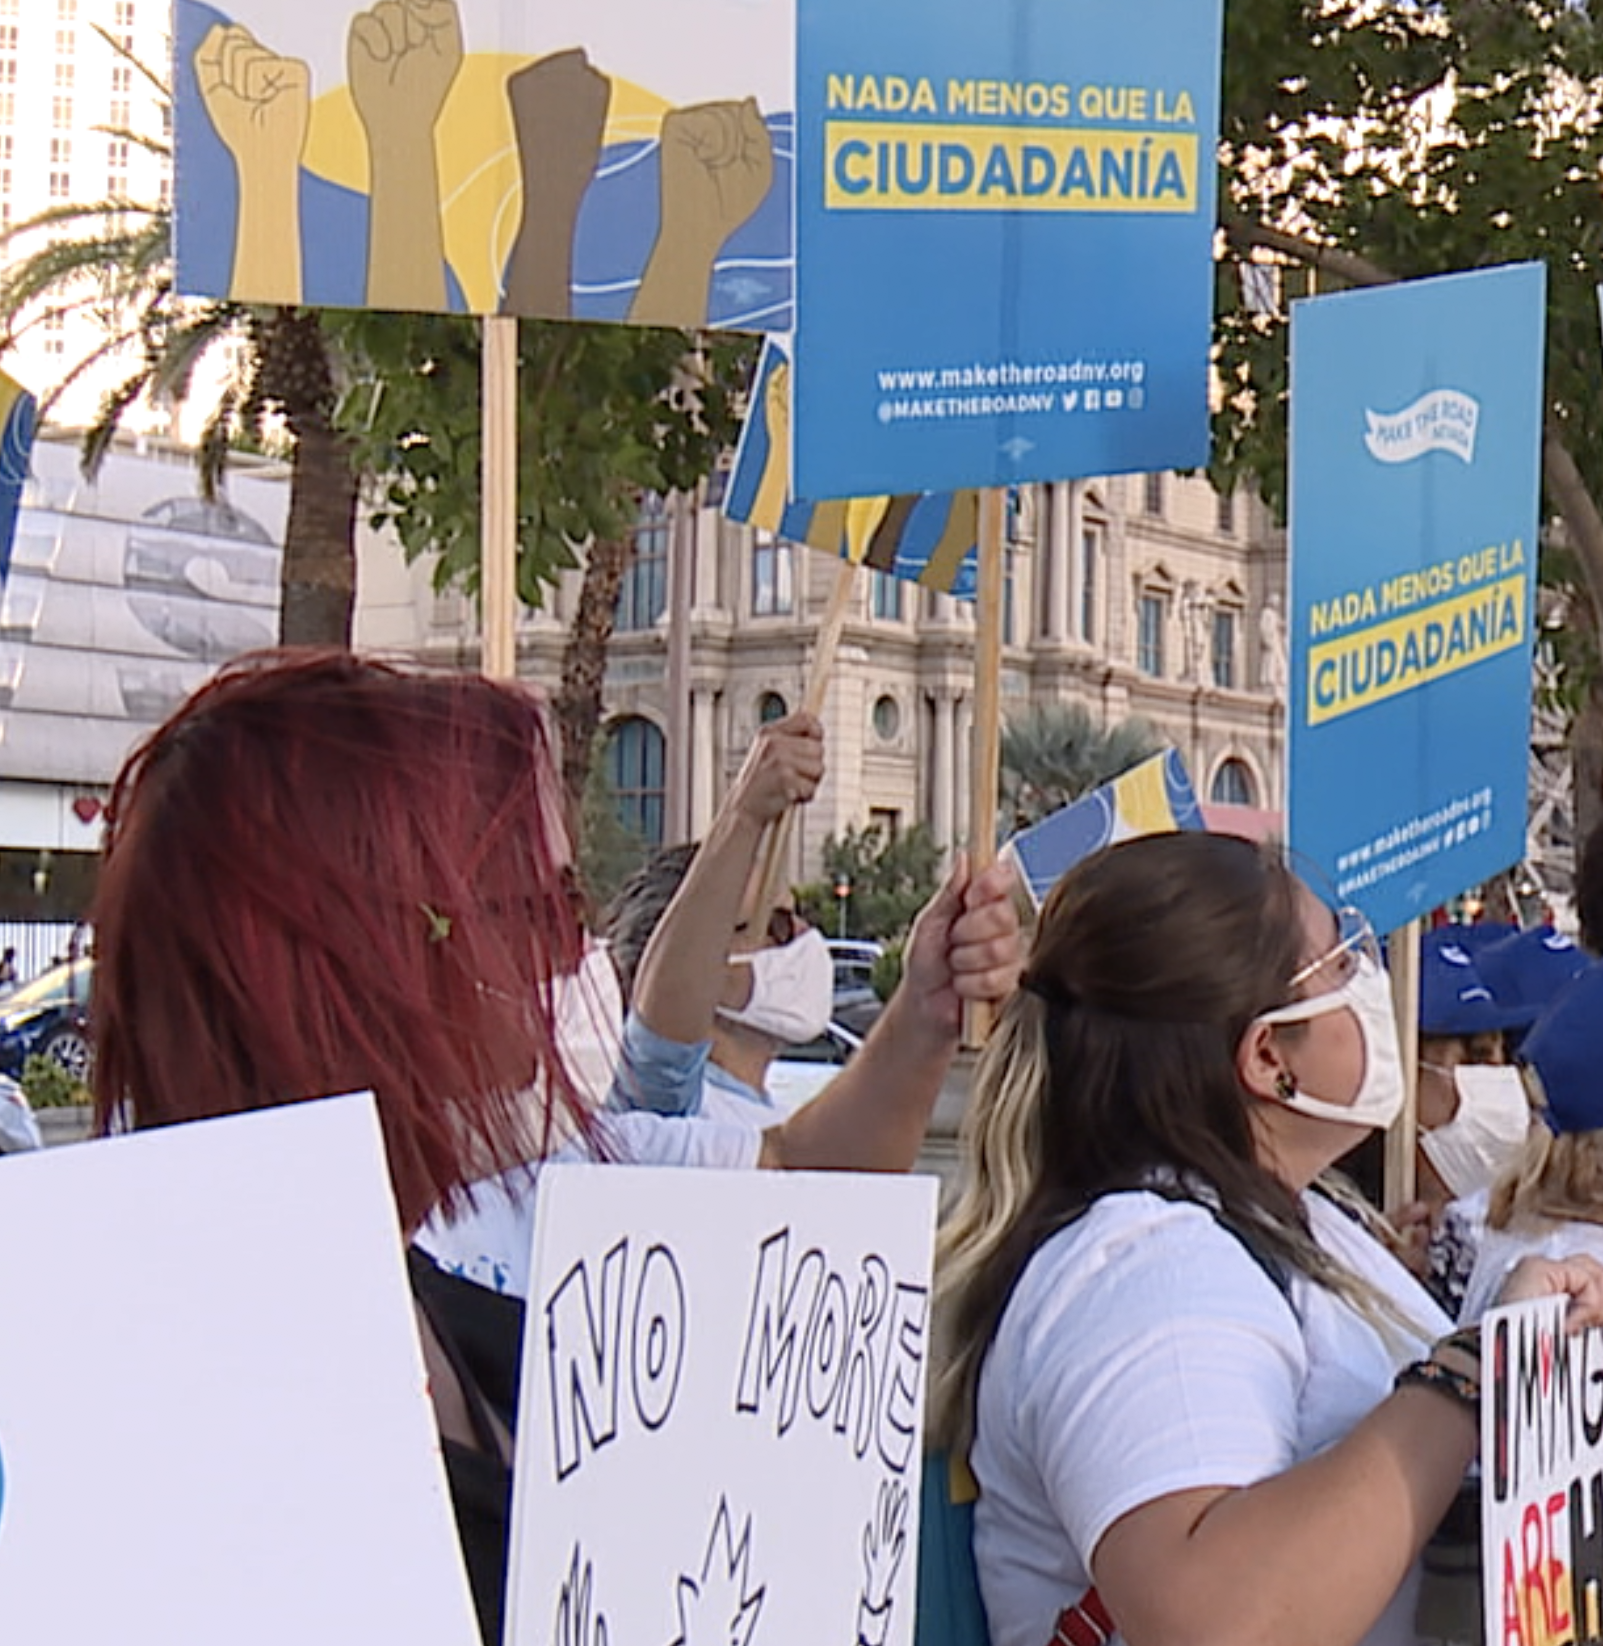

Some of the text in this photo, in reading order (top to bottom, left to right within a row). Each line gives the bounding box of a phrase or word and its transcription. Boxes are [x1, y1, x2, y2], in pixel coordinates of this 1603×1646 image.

[827, 73, 1195, 124] NADA MENOS QUE LA
[833, 136, 1188, 199] CIUDADANÍA
[877, 359, 1145, 391] www.maketheroadnv.org
[877, 393, 1054, 423] @MAKETHEROADNV
[1310, 539, 1526, 639] NADA MENOS QUE LA
[1314, 585, 1518, 708] CIUDADANÍA
[545, 1224, 929, 1484] NO MORE
[1503, 1491, 1572, 1646] ARE
